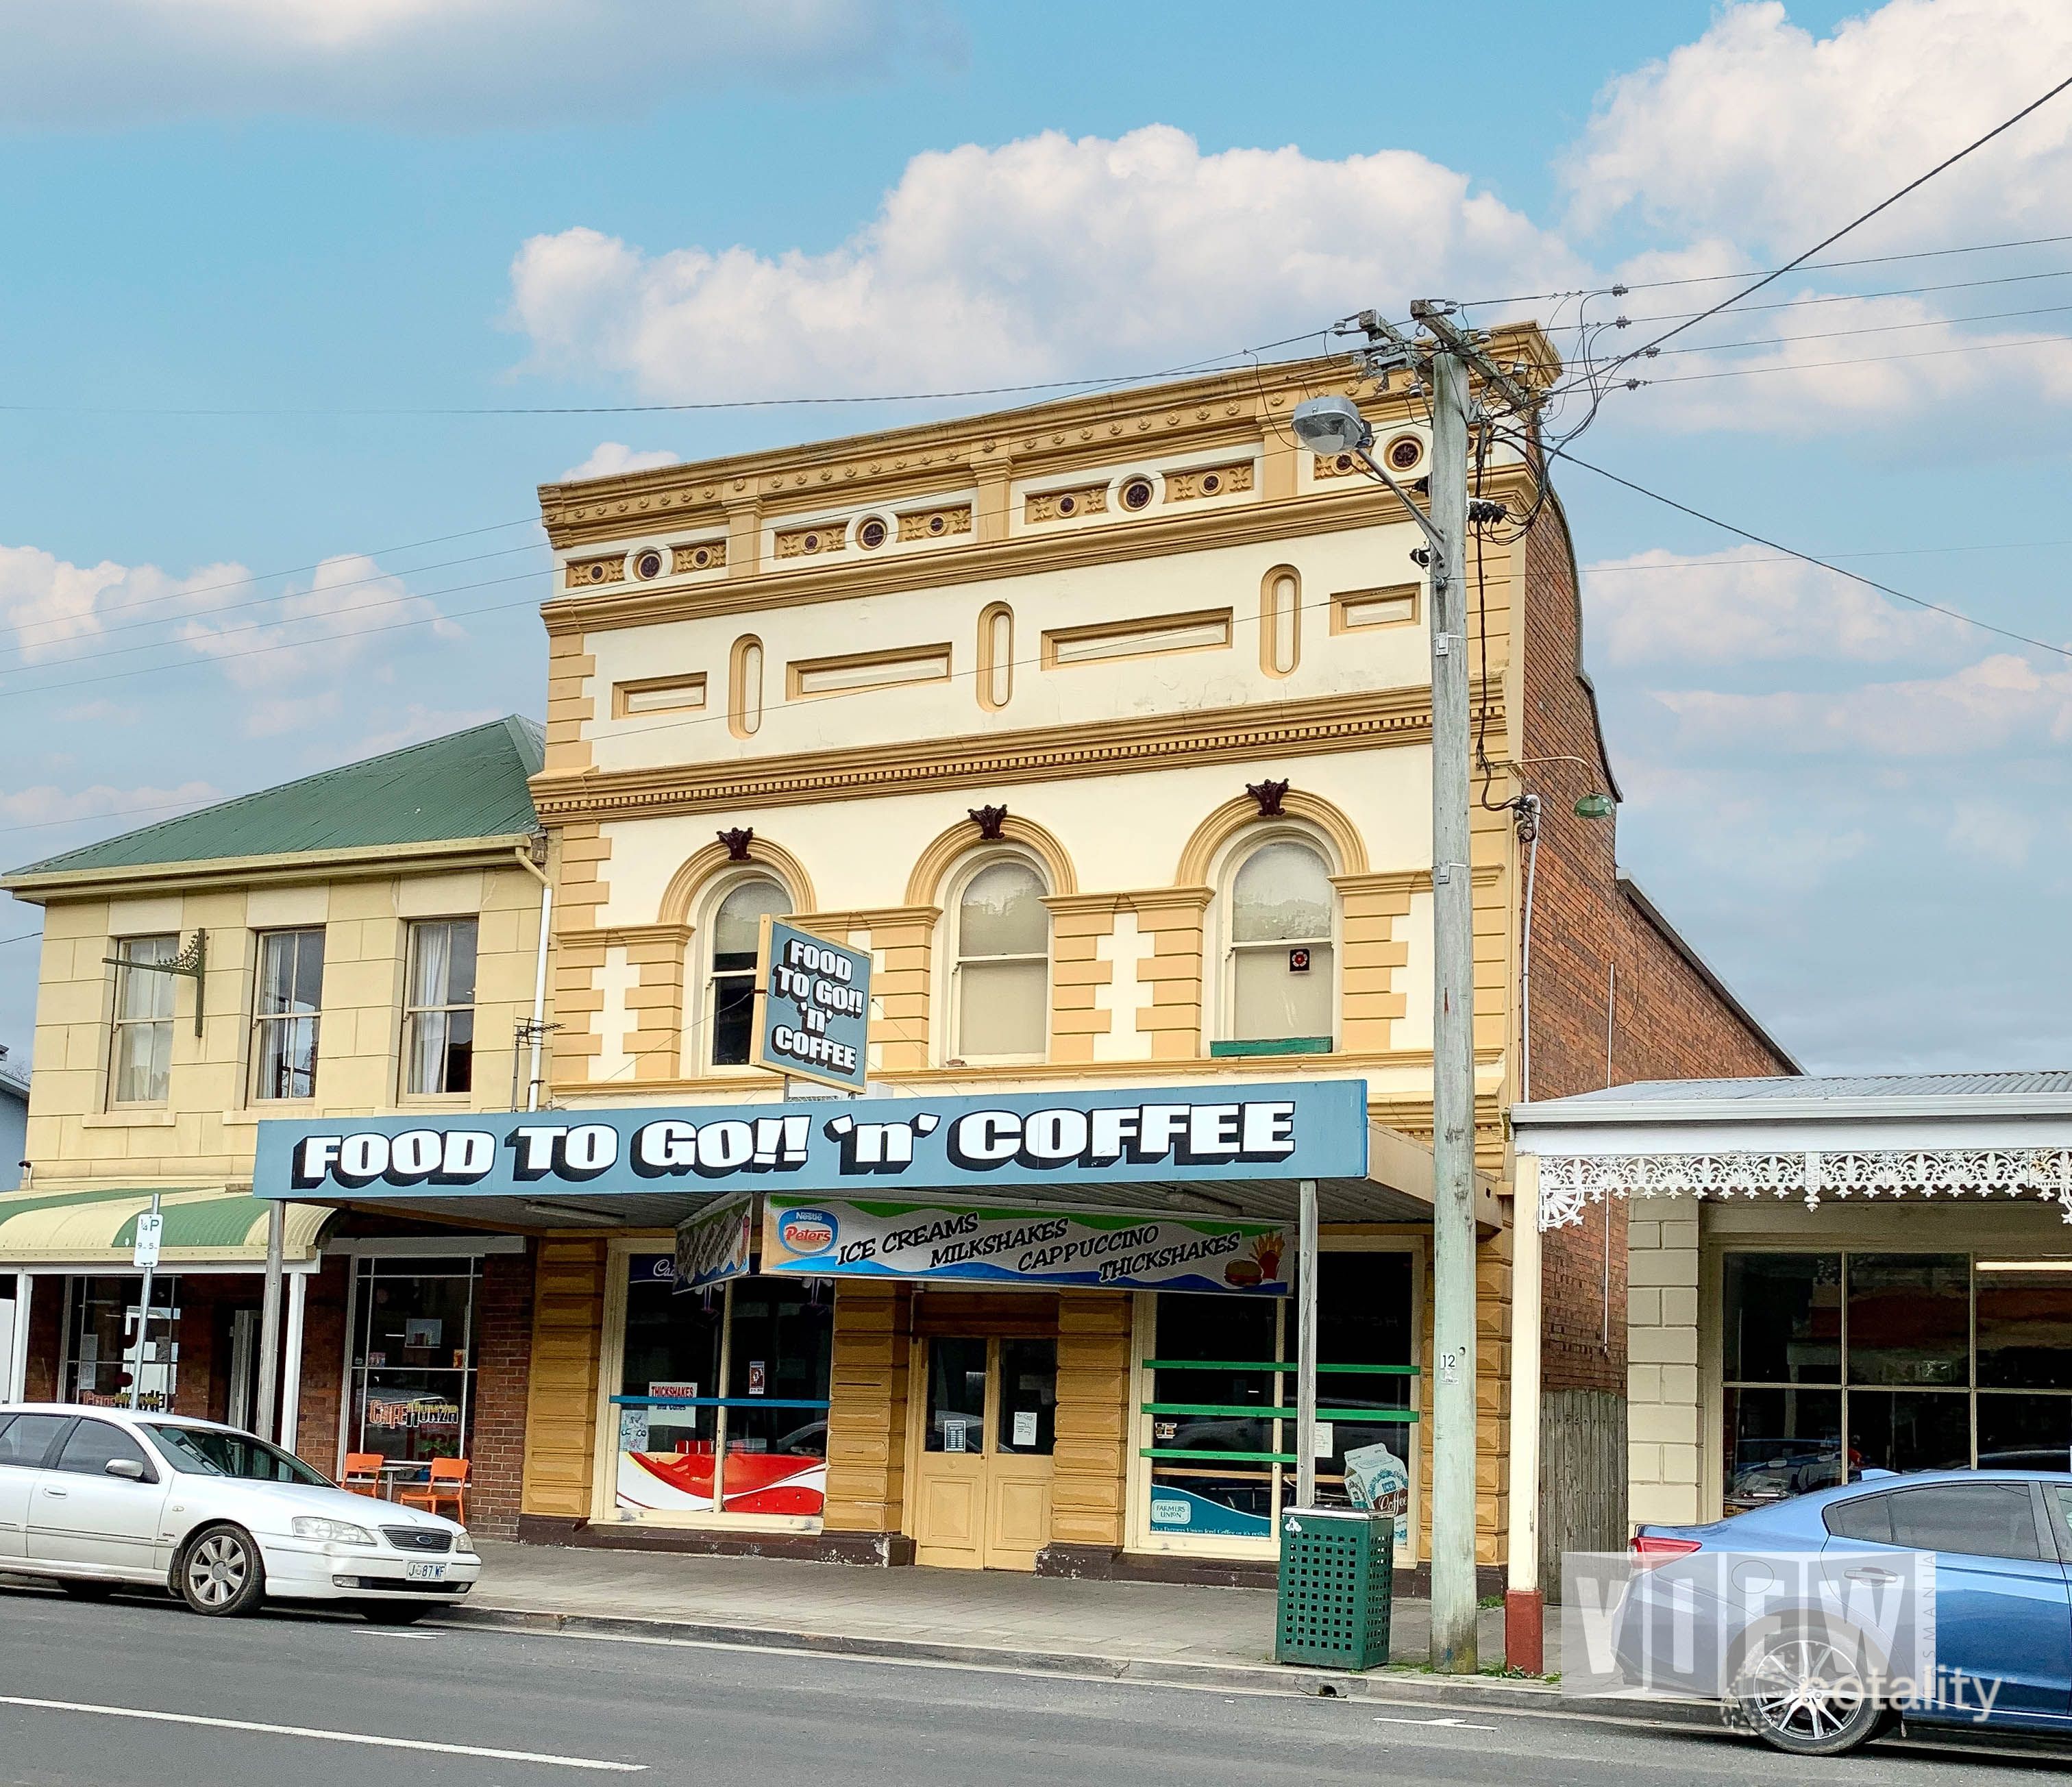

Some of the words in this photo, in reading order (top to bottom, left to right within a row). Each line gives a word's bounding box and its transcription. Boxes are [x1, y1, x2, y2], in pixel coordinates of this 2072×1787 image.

[784, 939, 852, 985] FOOD
[773, 964, 811, 1002] TO
[813, 978, 864, 1019] GO!!
[772, 1025, 856, 1074] COFFEE
[292, 1130, 495, 1189] FOOD
[505, 1123, 619, 1181] TO
[630, 1115, 813, 1178] GO!!
[946, 1101, 1296, 1172] COFFEE
[150, 1220, 160, 1231] P
[785, 1226, 831, 1242] Peters
[837, 1237, 876, 1265] ICE
[882, 1213, 978, 1253] CREAMS
[930, 1218, 1070, 1268] MILKSHAKES
[1018, 1225, 1159, 1272] CAPPUCCINO
[1099, 1231, 1241, 1282] THICKSHAKES
[1443, 1355, 1455, 1368] 12
[652, 1385, 694, 1398] THICKSHAKES
